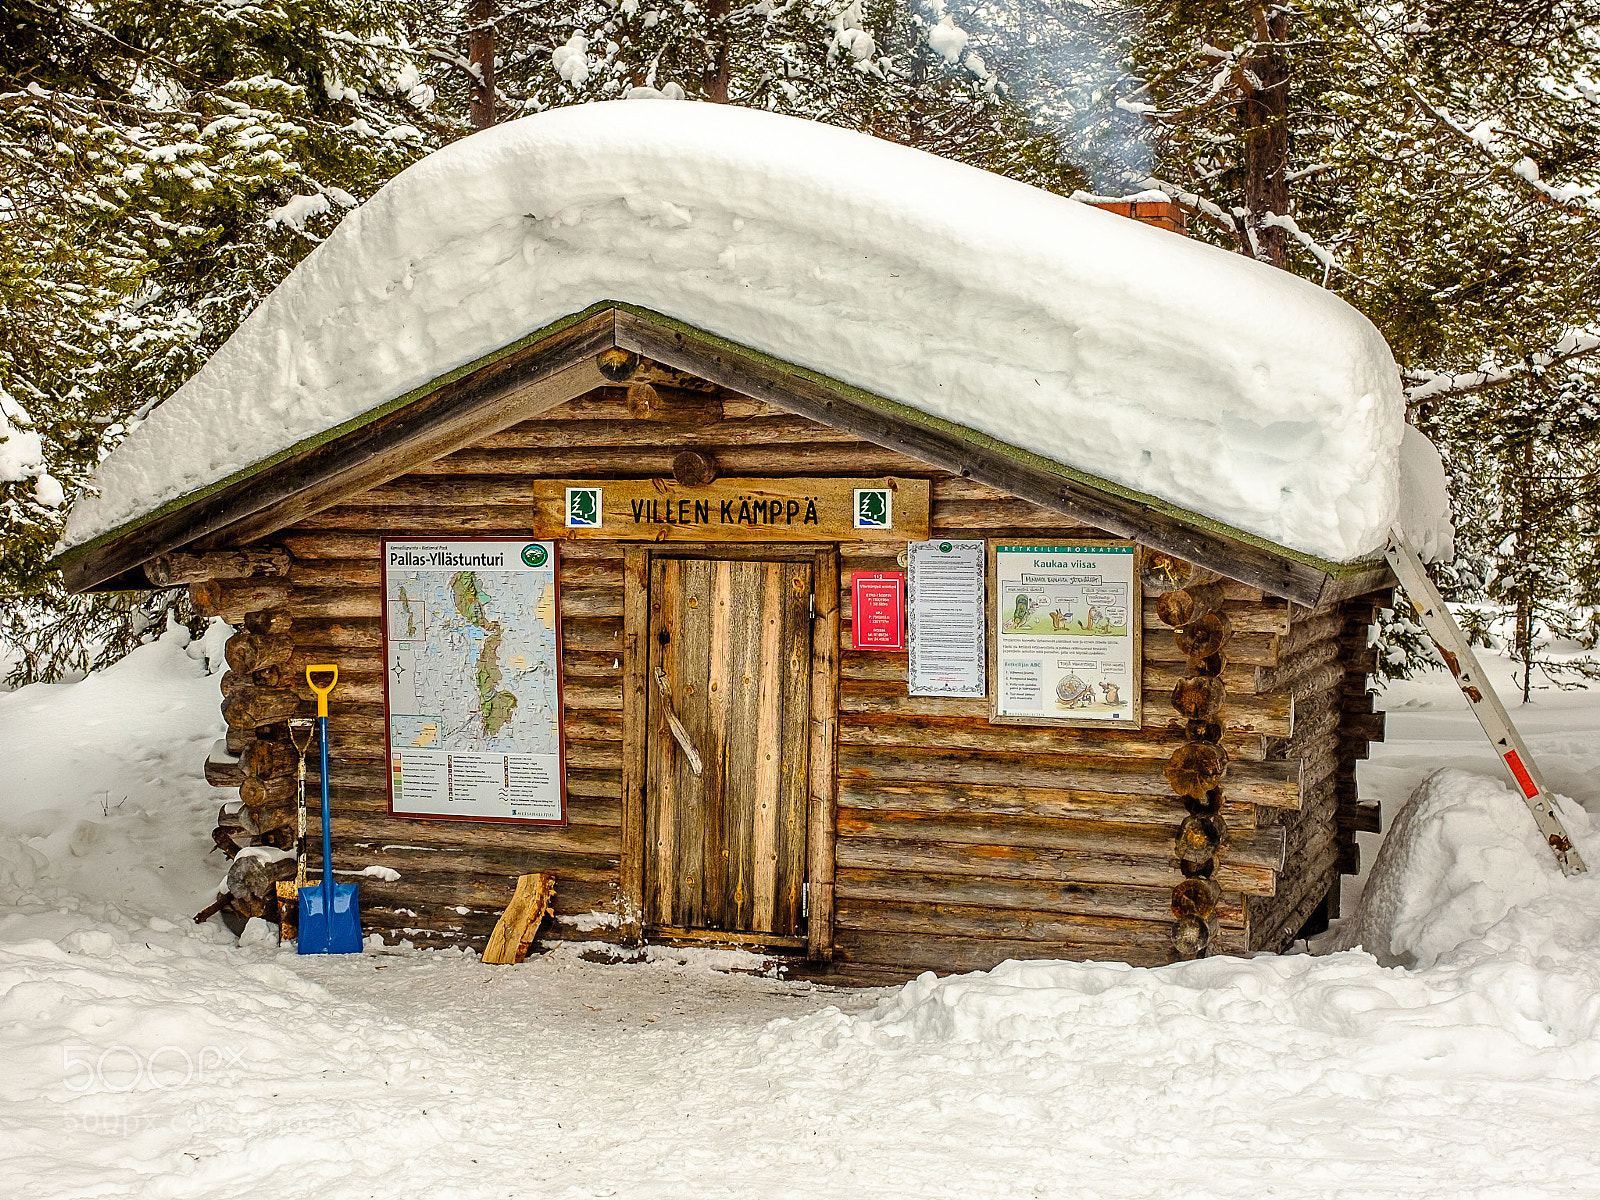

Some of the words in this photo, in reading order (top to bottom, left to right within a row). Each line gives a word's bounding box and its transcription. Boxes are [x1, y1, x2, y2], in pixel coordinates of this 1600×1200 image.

[631, 499, 709, 525] VILLEN
[720, 495, 819, 525] KÄMPPÄ
[390, 552, 504, 567] Pallas-Yllästunturi
[1033, 559, 1068, 568] Kaukaa
[1071, 560, 1097, 569] viisas
